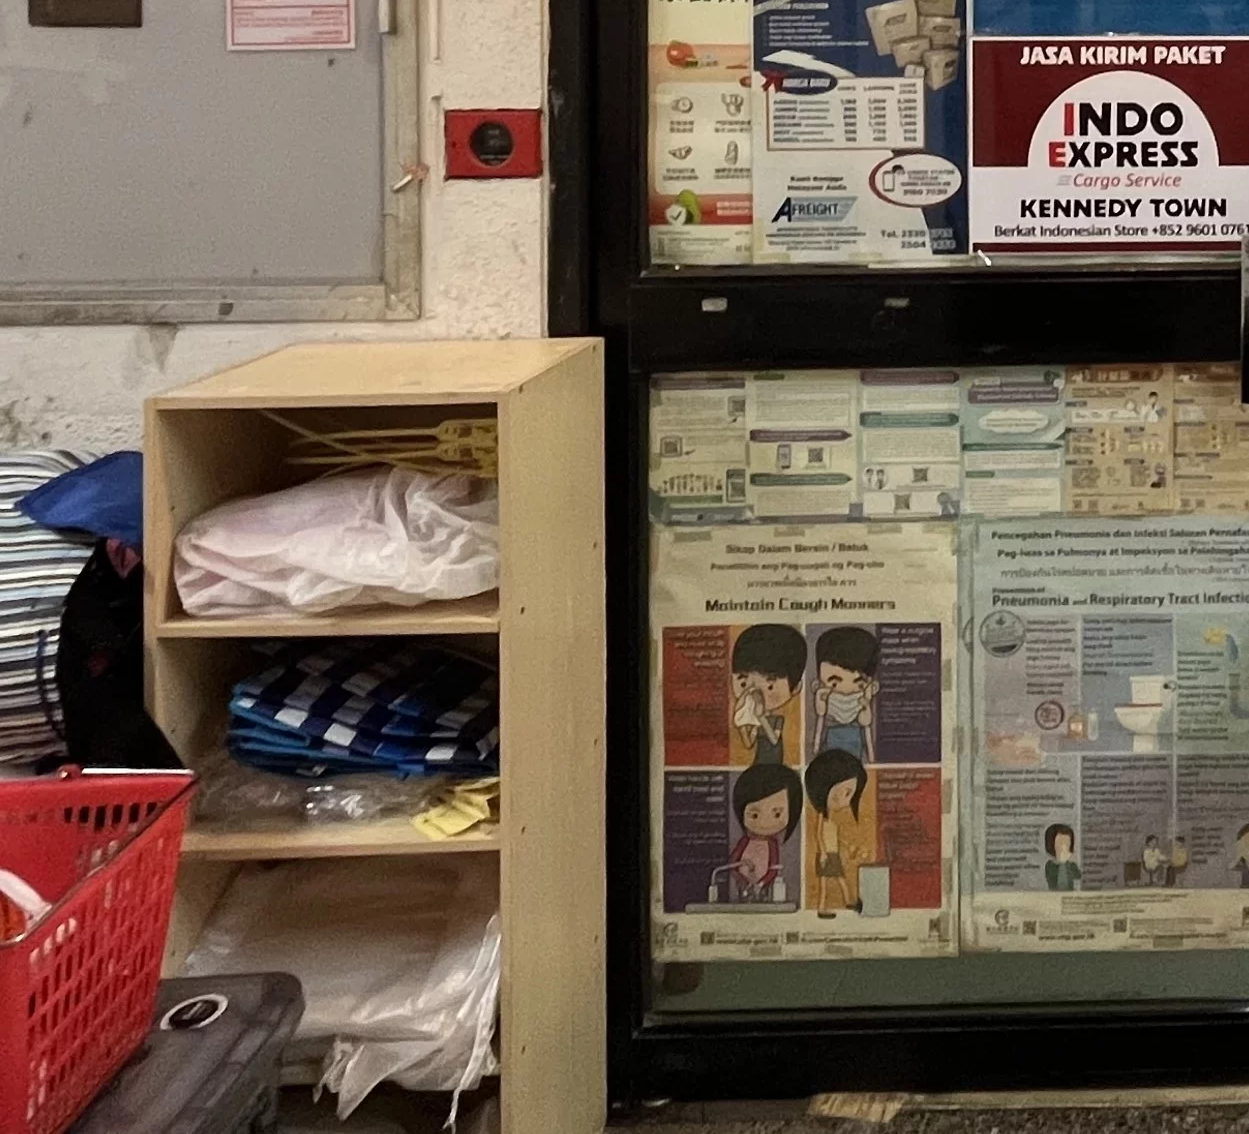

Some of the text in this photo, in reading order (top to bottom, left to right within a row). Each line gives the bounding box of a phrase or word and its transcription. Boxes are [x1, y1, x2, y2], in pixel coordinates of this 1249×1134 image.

[1020, 46, 1226, 66] JASA KIRIM PAKET
[1064, 102, 1184, 136] INDO
[1049, 141, 1198, 168] EXPRESS
[1073, 173, 1182, 190] Cargo Service
[1020, 199, 1227, 218] KENNEDY TOWN
[994, 224, 1037, 237] Berkat
[1040, 224, 1111, 237] Indonesian
[1114, 224, 1148, 236] Store
[1152, 224, 1182, 236] +852
[1186, 224, 1217, 236] 9601
[705, 597, 896, 613] Maintain Cough Manners
[992, 593, 1069, 607] Pneumonia
[1089, 593, 1165, 608] Respiratory
[1168, 593, 1200, 606] Tract
